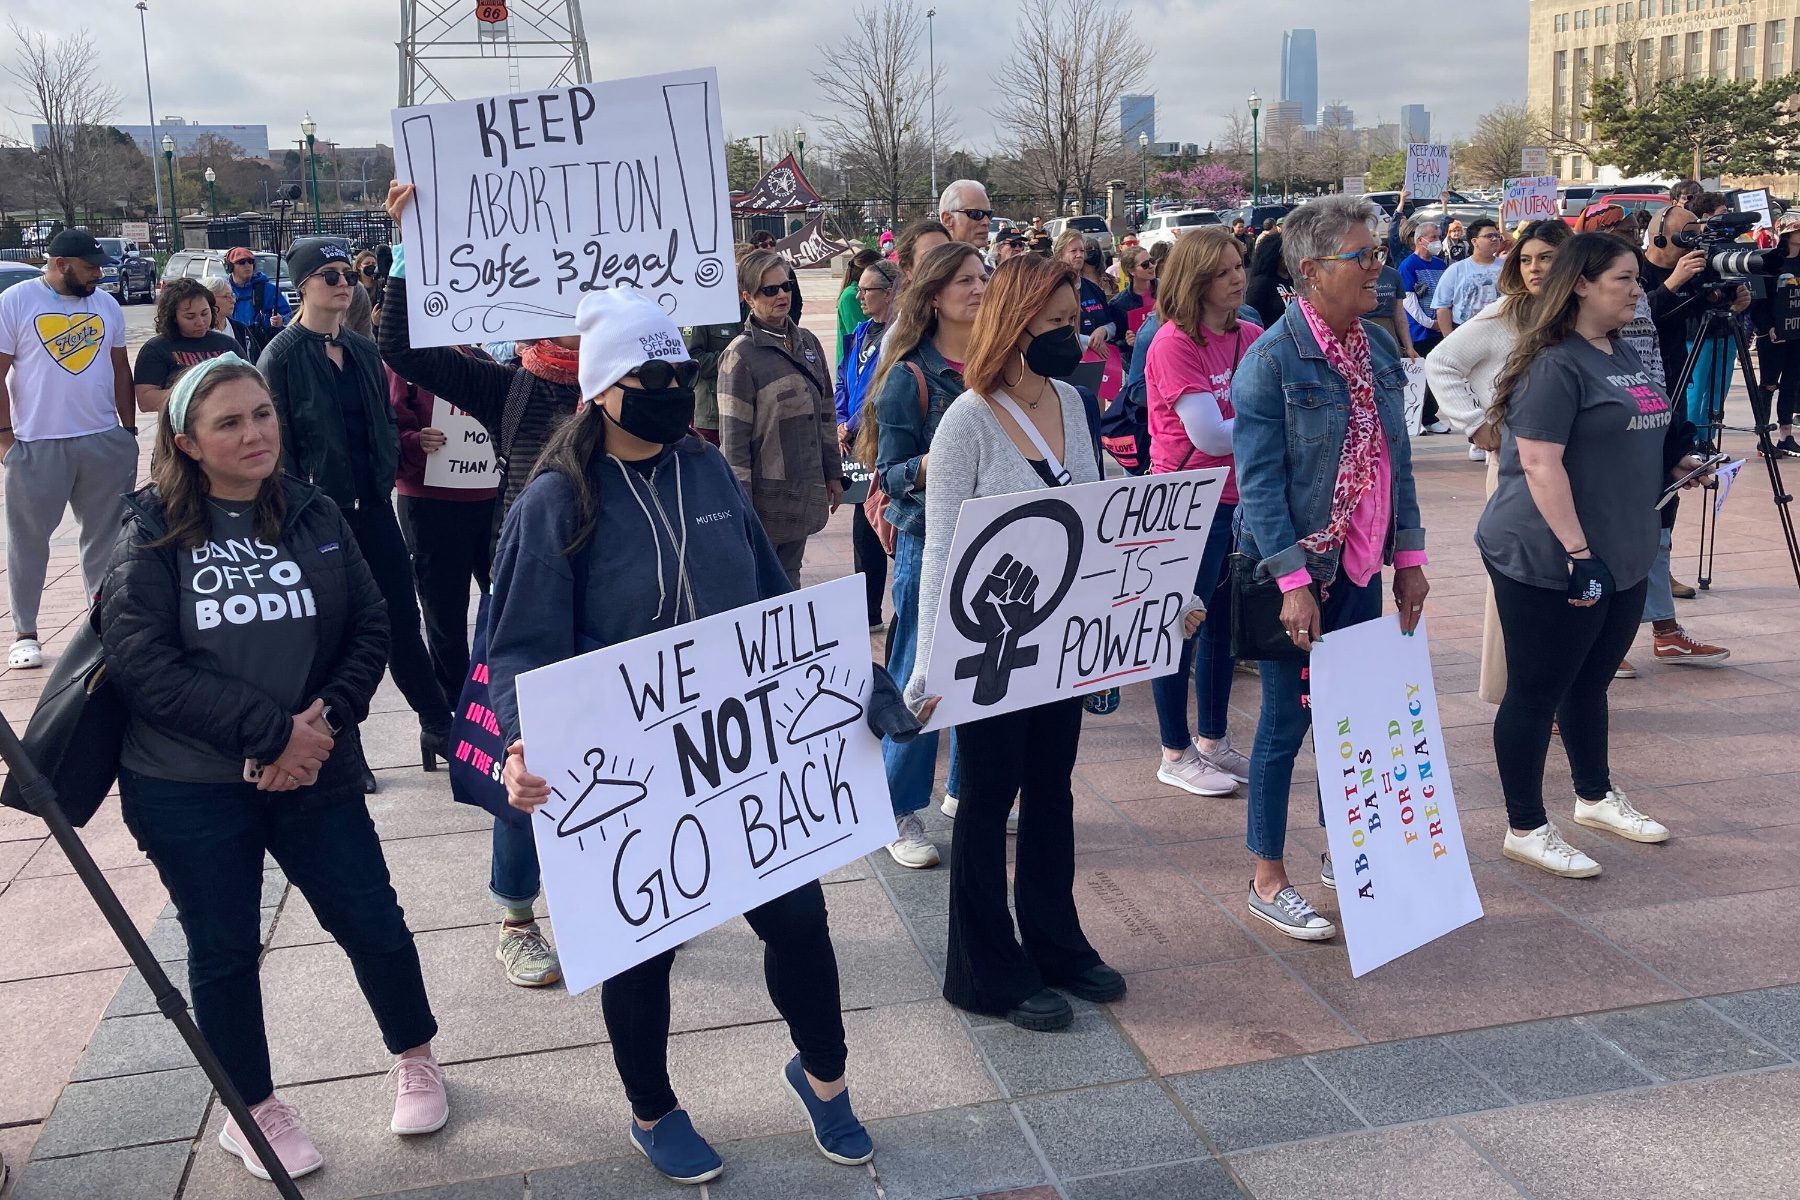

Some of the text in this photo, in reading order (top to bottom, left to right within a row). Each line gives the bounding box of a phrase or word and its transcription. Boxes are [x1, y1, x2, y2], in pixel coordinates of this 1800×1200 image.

[483, 7, 501, 19] 66
[1646, 8, 1748, 29] STATE OF OKLAHOMA
[476, 86, 596, 168] KEEP
[1409, 143, 1448, 158] KEEP YOUR
[1416, 158, 1440, 173] BAN
[1412, 172, 1440, 183] OFF MY
[467, 155, 662, 244] ABORTION
[1413, 182, 1446, 199] BODY
[1505, 195, 1558, 219] MY UTERUS
[449, 243, 540, 297] Safe
[639, 331, 669, 345] BANS
[643, 339, 682, 352] OFF OUR
[647, 347, 681, 360] BODIES
[463, 430, 490, 445] MO
[1115, 443, 1135, 453] LOVE
[448, 459, 488, 474] THAN
[851, 471, 875, 483] Care
[695, 509, 733, 525] MUTESIX
[1097, 478, 1217, 544] CHOICE
[192, 563, 264, 594] OFF
[1112, 545, 1159, 600] IS
[1589, 579, 1597, 597] OUR
[1056, 591, 1184, 689] POWER
[619, 601, 839, 721] WE WILL
[465, 702, 486, 724] IN
[672, 680, 780, 798] NOT
[455, 739, 473, 762] IN
[471, 747, 494, 776] THE
[1387, 719, 1419, 846] FORCED
[1404, 683, 1448, 860] PREGNANCY
[1358, 748, 1383, 834] BANS
[1336, 715, 1375, 900] ABORTION
[612, 738, 859, 926] GO BACK
